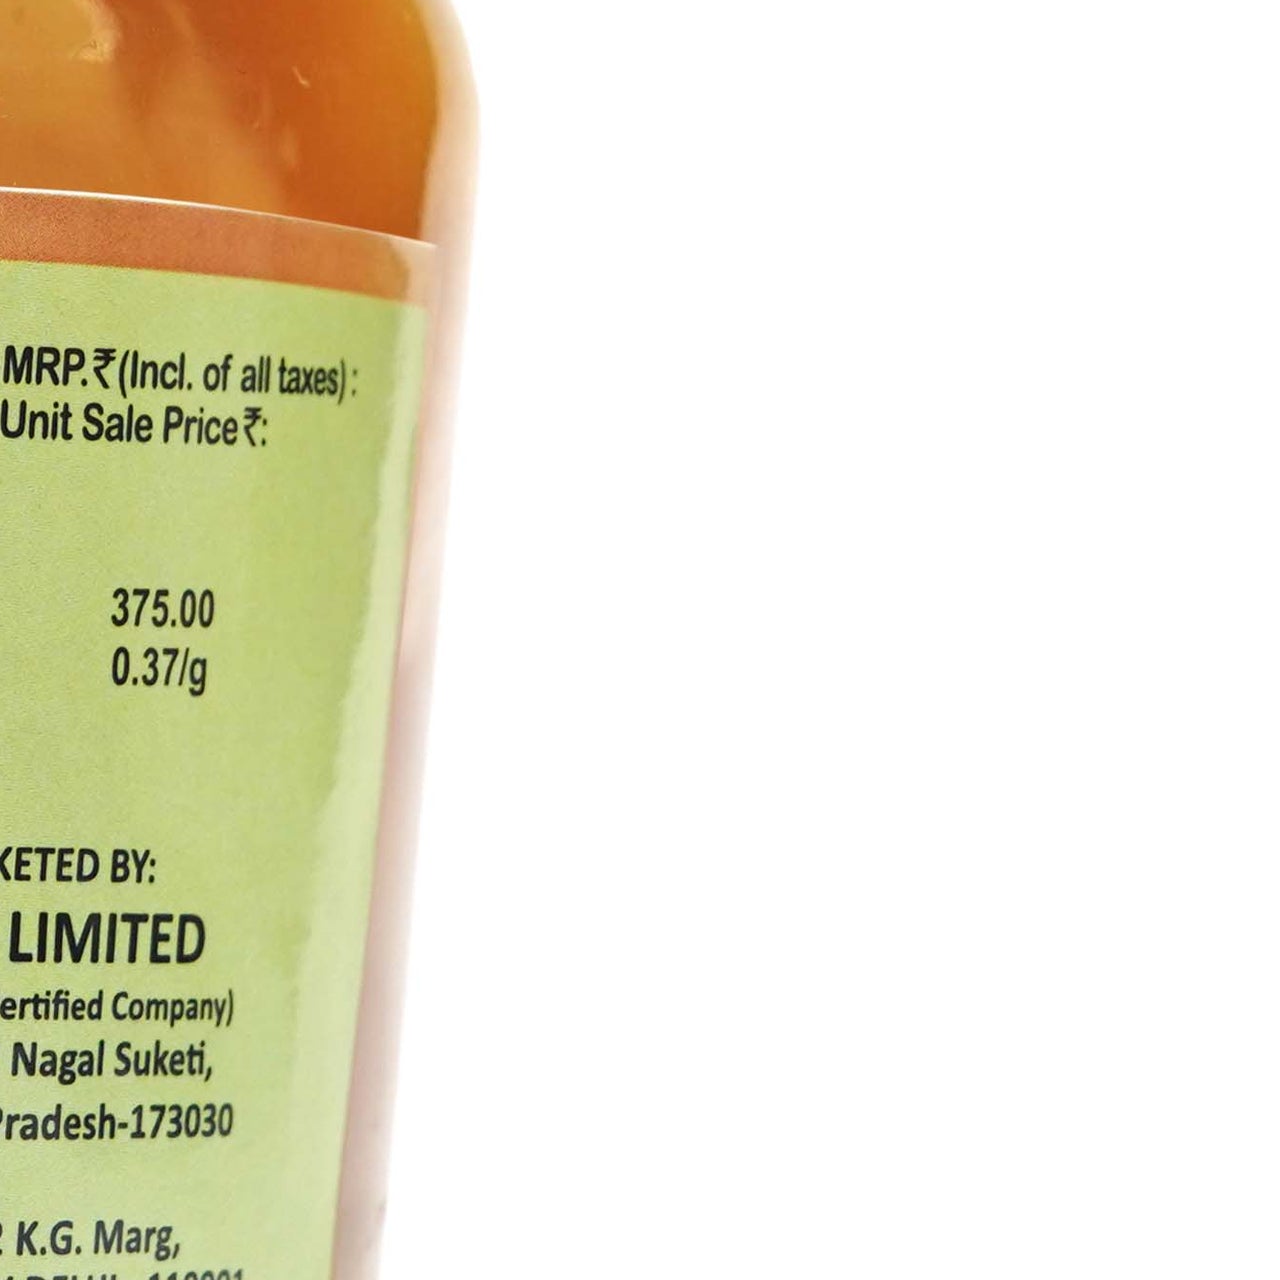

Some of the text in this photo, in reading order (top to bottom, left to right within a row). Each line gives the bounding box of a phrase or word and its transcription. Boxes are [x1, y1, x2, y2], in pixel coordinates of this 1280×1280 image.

[203, 353, 234, 392] of
[240, 355, 271, 393] all
[278, 355, 348, 406] taxes)
[0, 398, 74, 441] Unit
[81, 402, 154, 443] Sale
[110, 587, 215, 629] 375.00
[111, 646, 207, 697] 0.37/g
[110, 848, 156, 884] BY:
[8, 910, 206, 965] LIMITED
[111, 989, 234, 1028] Company)
[11, 1039, 105, 1086] Nagal
[113, 1039, 212, 1082] Suketi,
[16, 1220, 82, 1257] K.G.
[93, 1219, 180, 1262] Marg,
